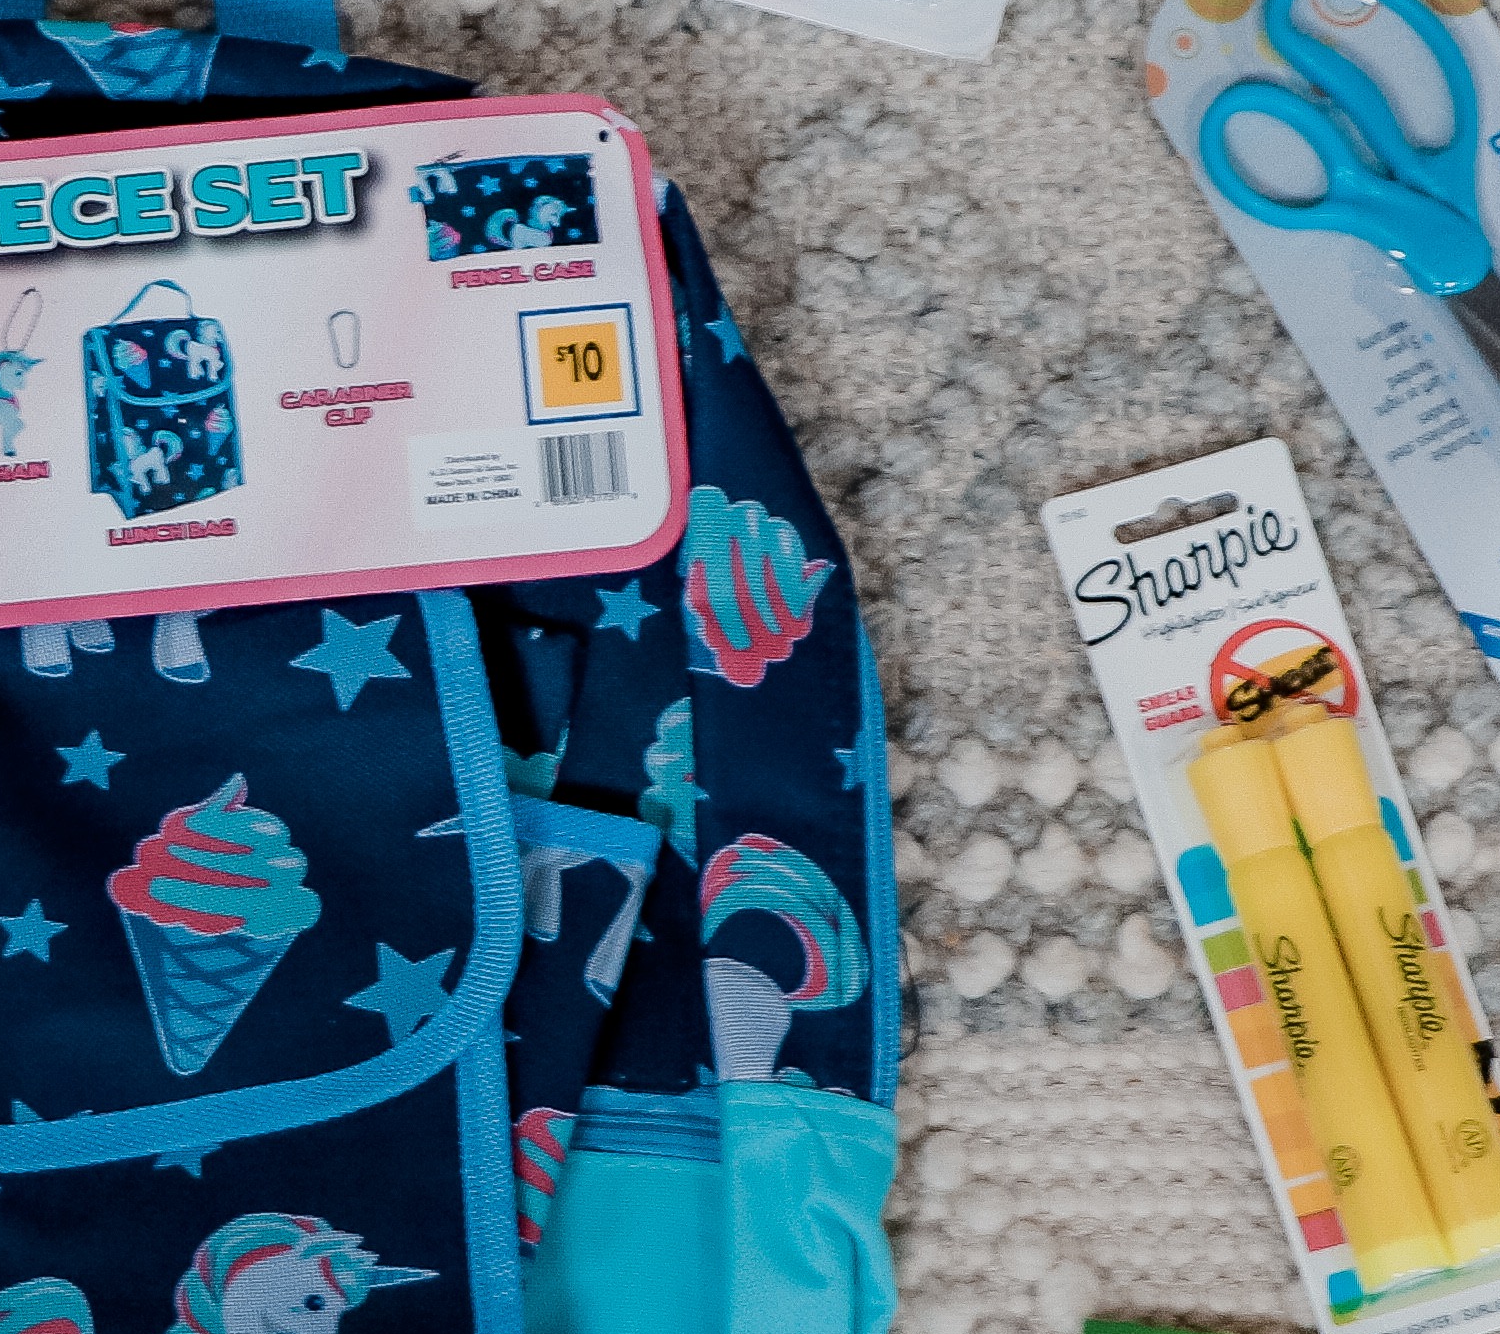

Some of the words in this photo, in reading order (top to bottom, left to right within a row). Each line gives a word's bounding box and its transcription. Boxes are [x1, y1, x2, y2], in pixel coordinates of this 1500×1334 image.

[194, 153, 362, 227] SET
[451, 266, 530, 289] PENCIL
[533, 260, 596, 281] CASE
[555, 341, 603, 383] $10
[281, 382, 414, 409] CARABINER
[325, 407, 373, 427] CLIP
[109, 523, 182, 547] LUNCH
[187, 518, 236, 540] BAG
[1076, 506, 1298, 646] Sharpie
[1377, 907, 1447, 1041] Sharpie
[1252, 933, 1320, 1066] Sharpie
